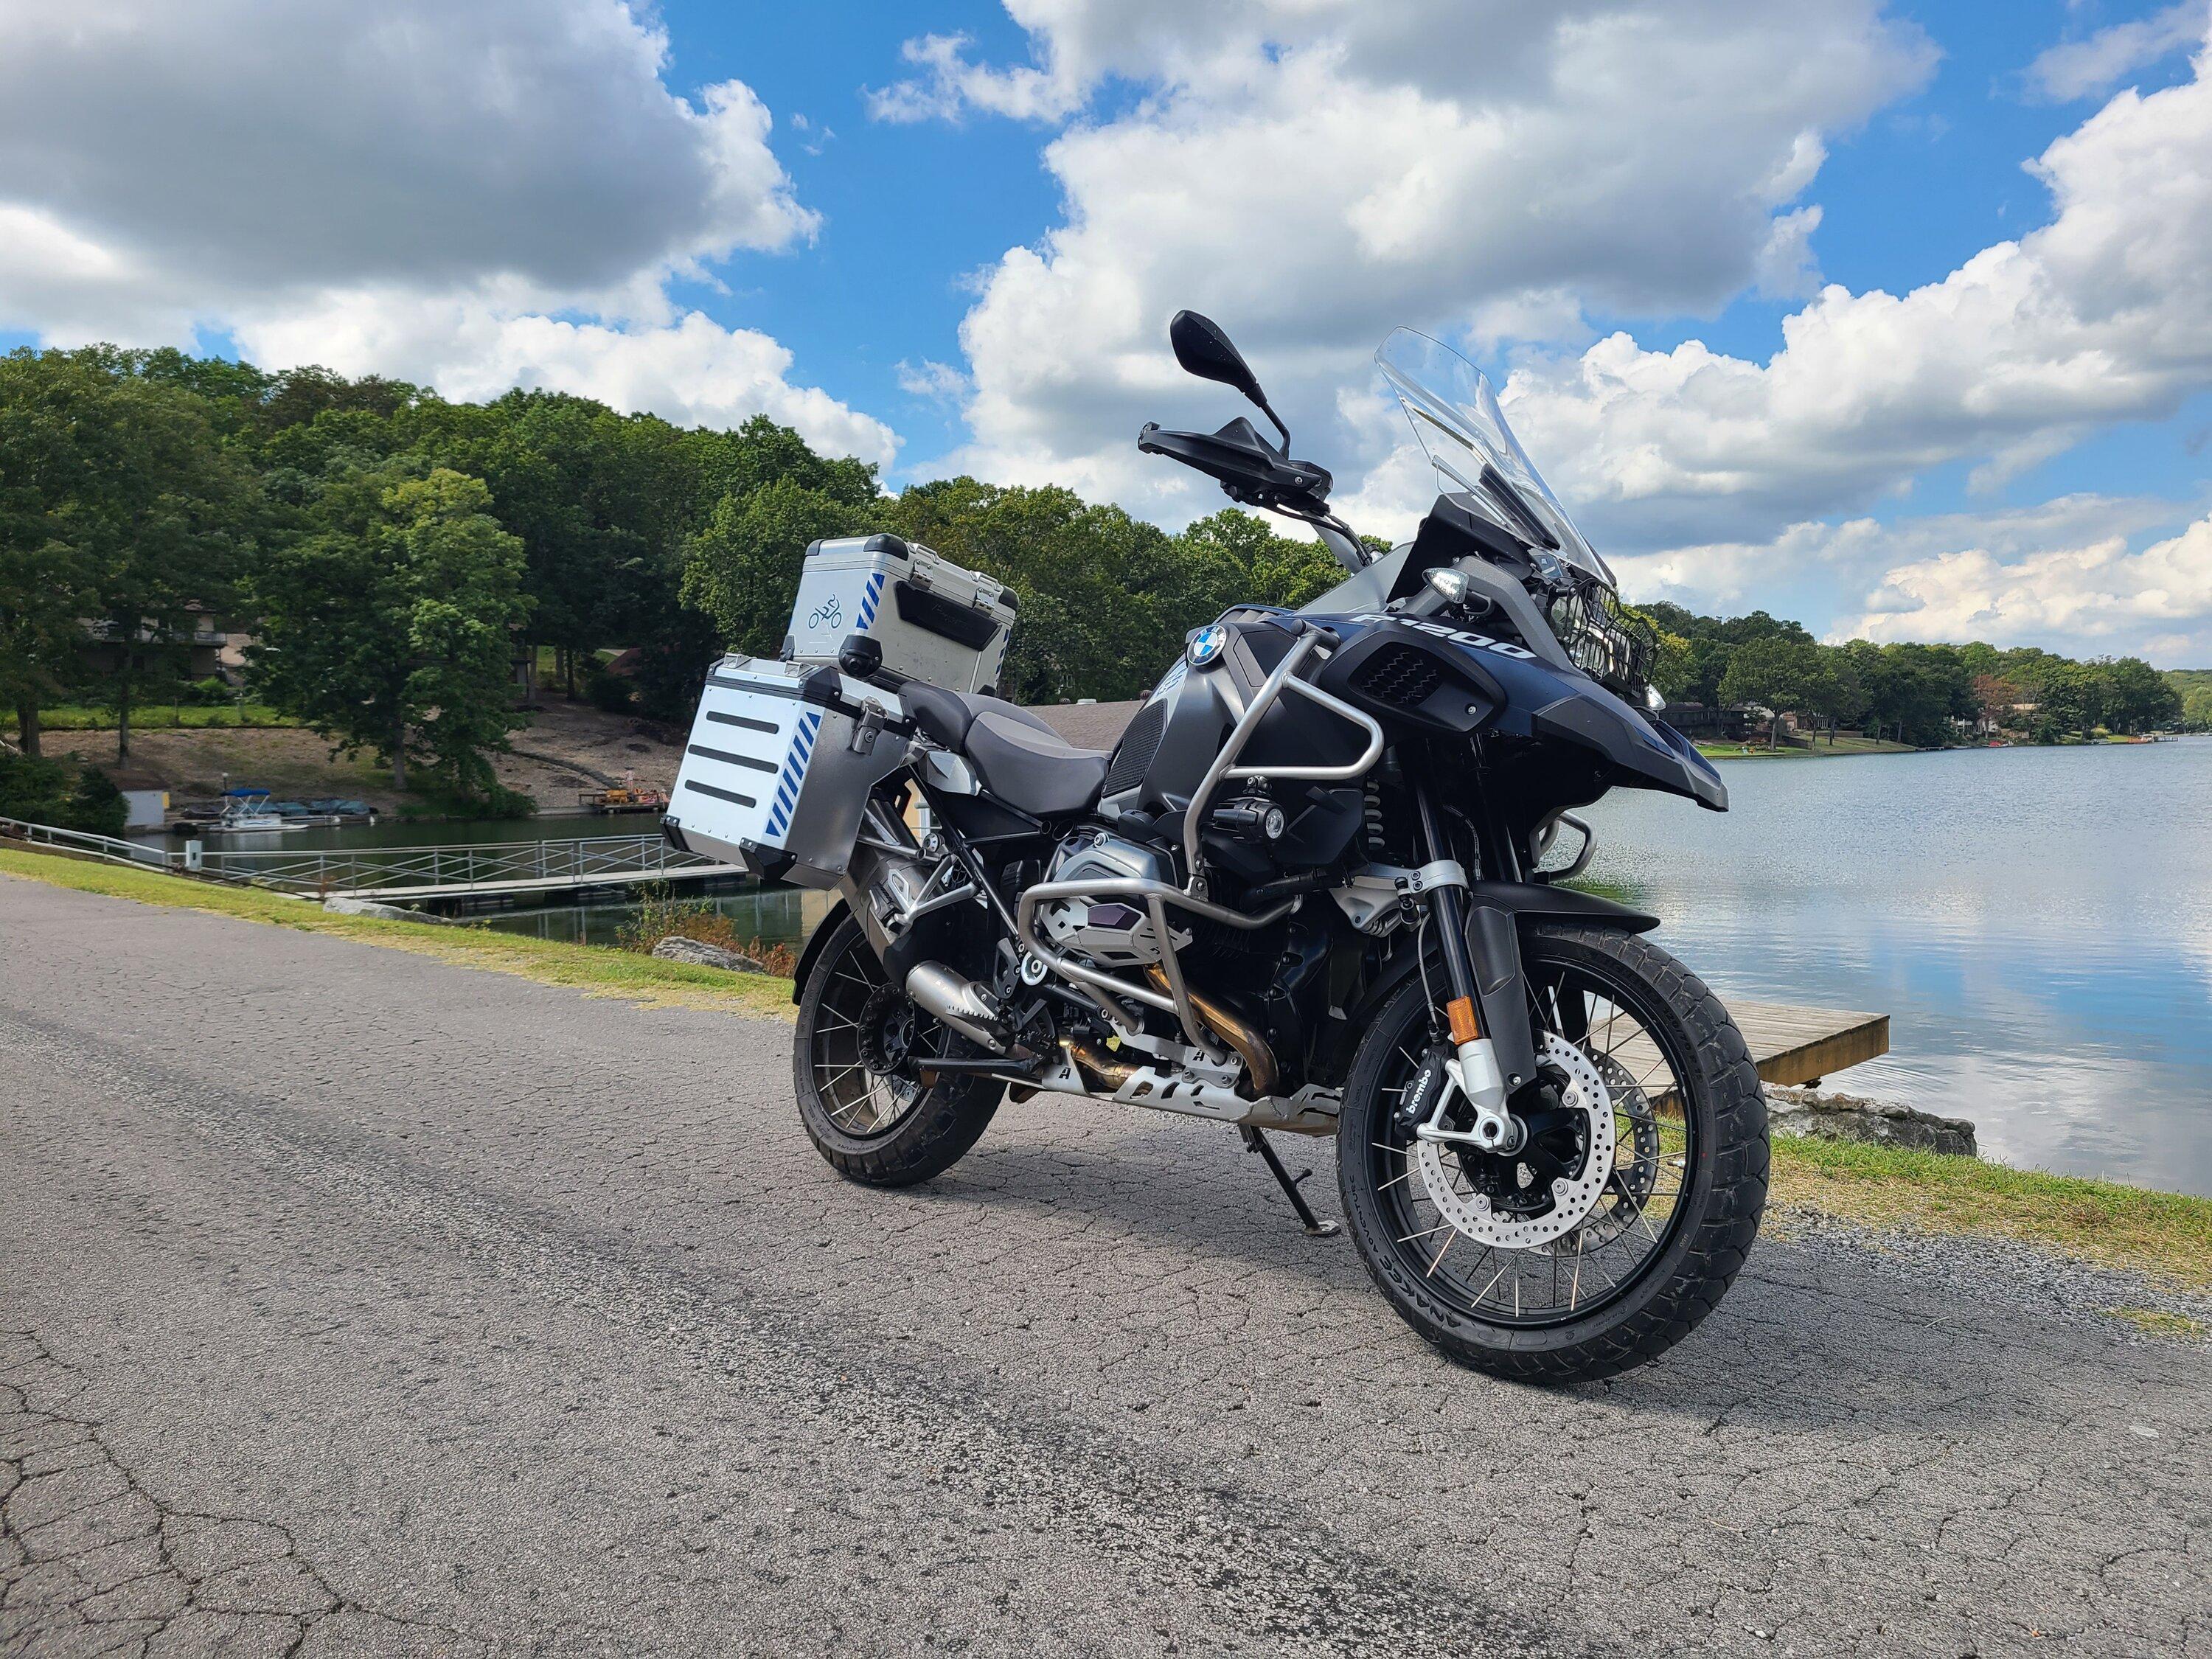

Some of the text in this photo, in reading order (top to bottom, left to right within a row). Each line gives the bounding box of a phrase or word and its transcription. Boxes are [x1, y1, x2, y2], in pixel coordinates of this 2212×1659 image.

[1405, 1068, 1431, 1114] brembo
[1349, 1175, 1461, 1326] ANAKEE ADVENTURE
